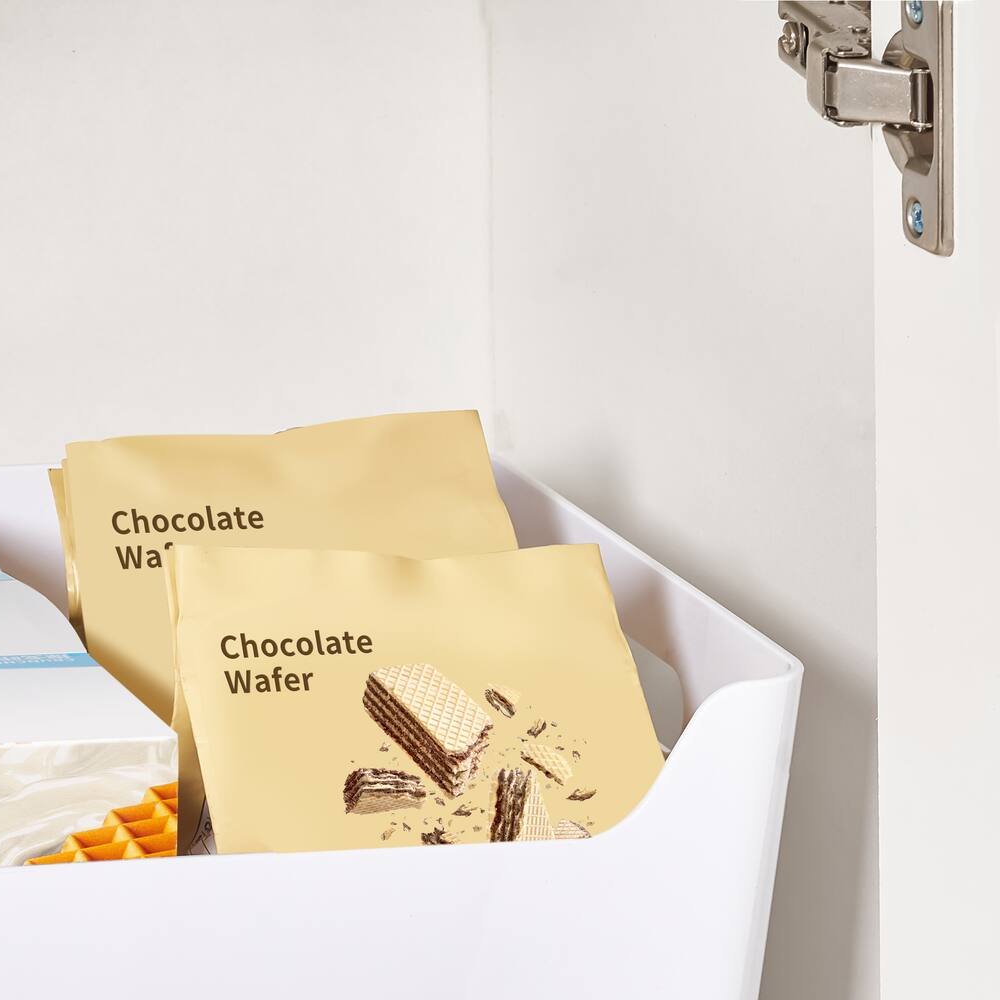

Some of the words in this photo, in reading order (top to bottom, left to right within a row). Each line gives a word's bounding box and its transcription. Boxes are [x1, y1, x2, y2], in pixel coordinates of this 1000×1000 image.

[111, 505, 264, 535] Chocolate
[220, 629, 373, 660] Chocolate
[223, 666, 314, 694] Wafer
